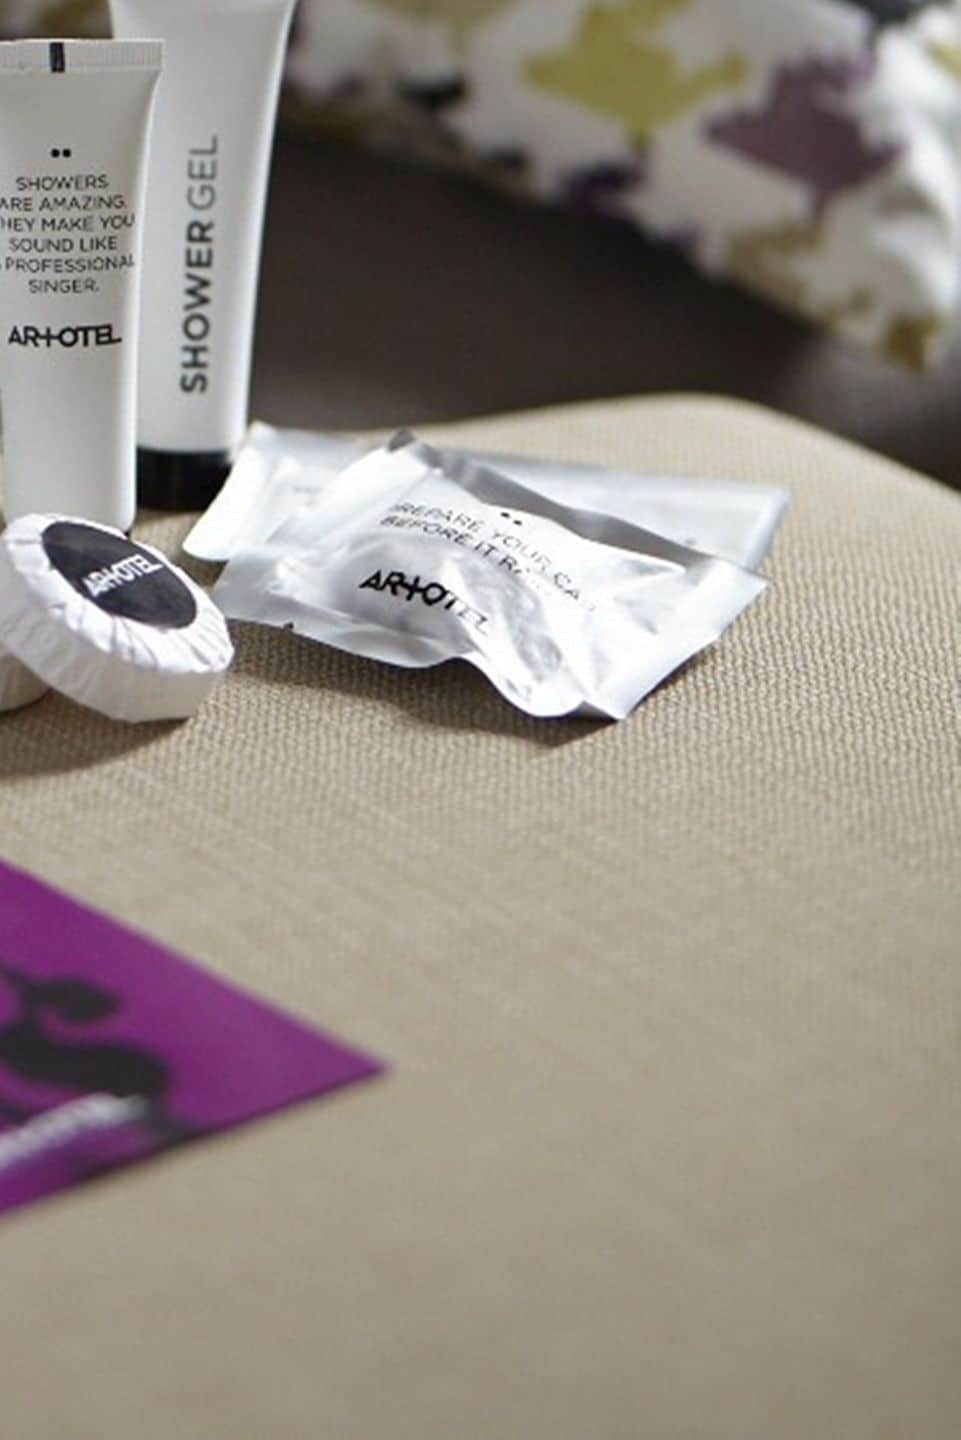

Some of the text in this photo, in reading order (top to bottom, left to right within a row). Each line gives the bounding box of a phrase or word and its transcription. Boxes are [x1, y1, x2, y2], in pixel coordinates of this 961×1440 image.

[15, 174, 110, 192] SHOWERS
[41, 215, 95, 232] MAKE
[100, 213, 136, 230] YOU
[9, 235, 118, 253] SOUND LIKE
[5, 254, 135, 274] PROFESSIONAL
[179, 134, 218, 394] SHOWER GEL
[380, 515, 499, 558] BEFORE IT
[492, 529, 553, 576] YOUR
